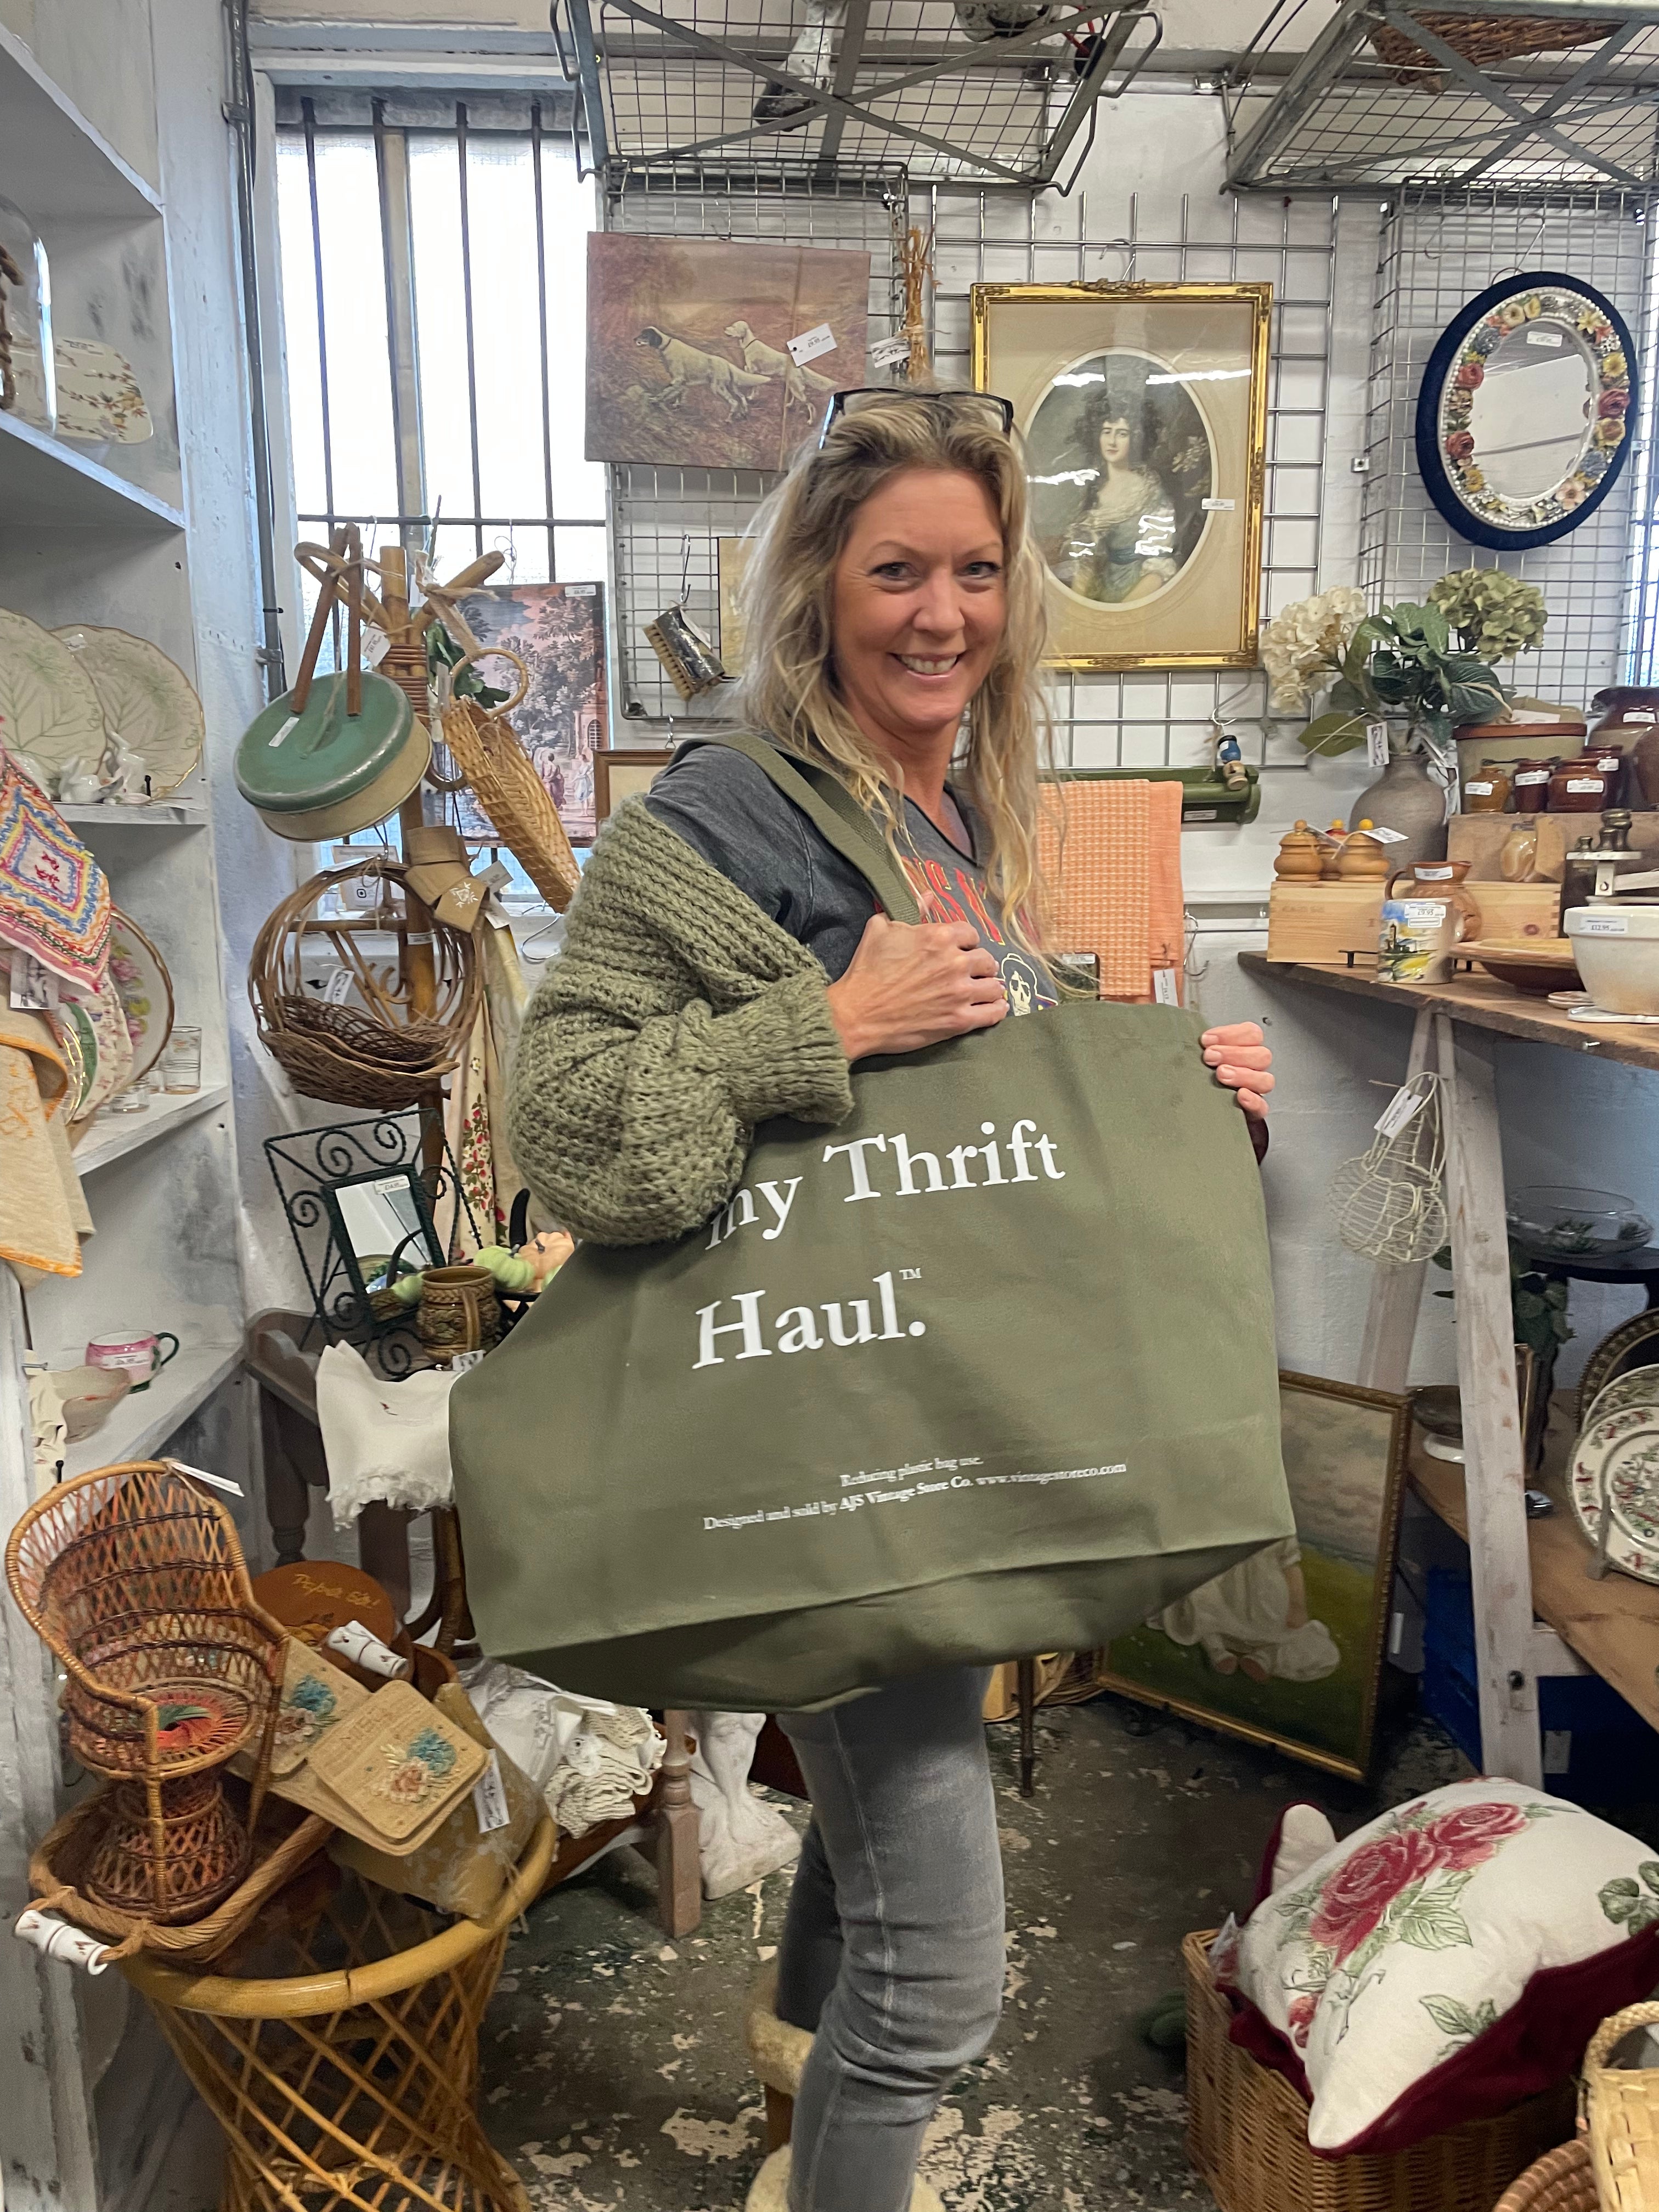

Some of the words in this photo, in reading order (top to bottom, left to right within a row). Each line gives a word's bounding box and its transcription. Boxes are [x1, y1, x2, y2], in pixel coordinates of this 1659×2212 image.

[704, 1175, 804, 1251] my
[822, 1119, 1066, 1203] Thrift
[691, 1271, 927, 1370] Haul.
[703, 1510, 764, 1530] Designed
[765, 1506, 791, 1520] and
[792, 1502, 820, 1517] sold
[820, 1500, 838, 1515] by
[865, 1488, 916, 1502] Vintage
[917, 1482, 950, 1494] Store
[950, 1476, 974, 1488] Co.
[839, 1469, 897, 1487] Reducing
[898, 1460, 934, 1480] plastic
[934, 1458, 958, 1471] bag
